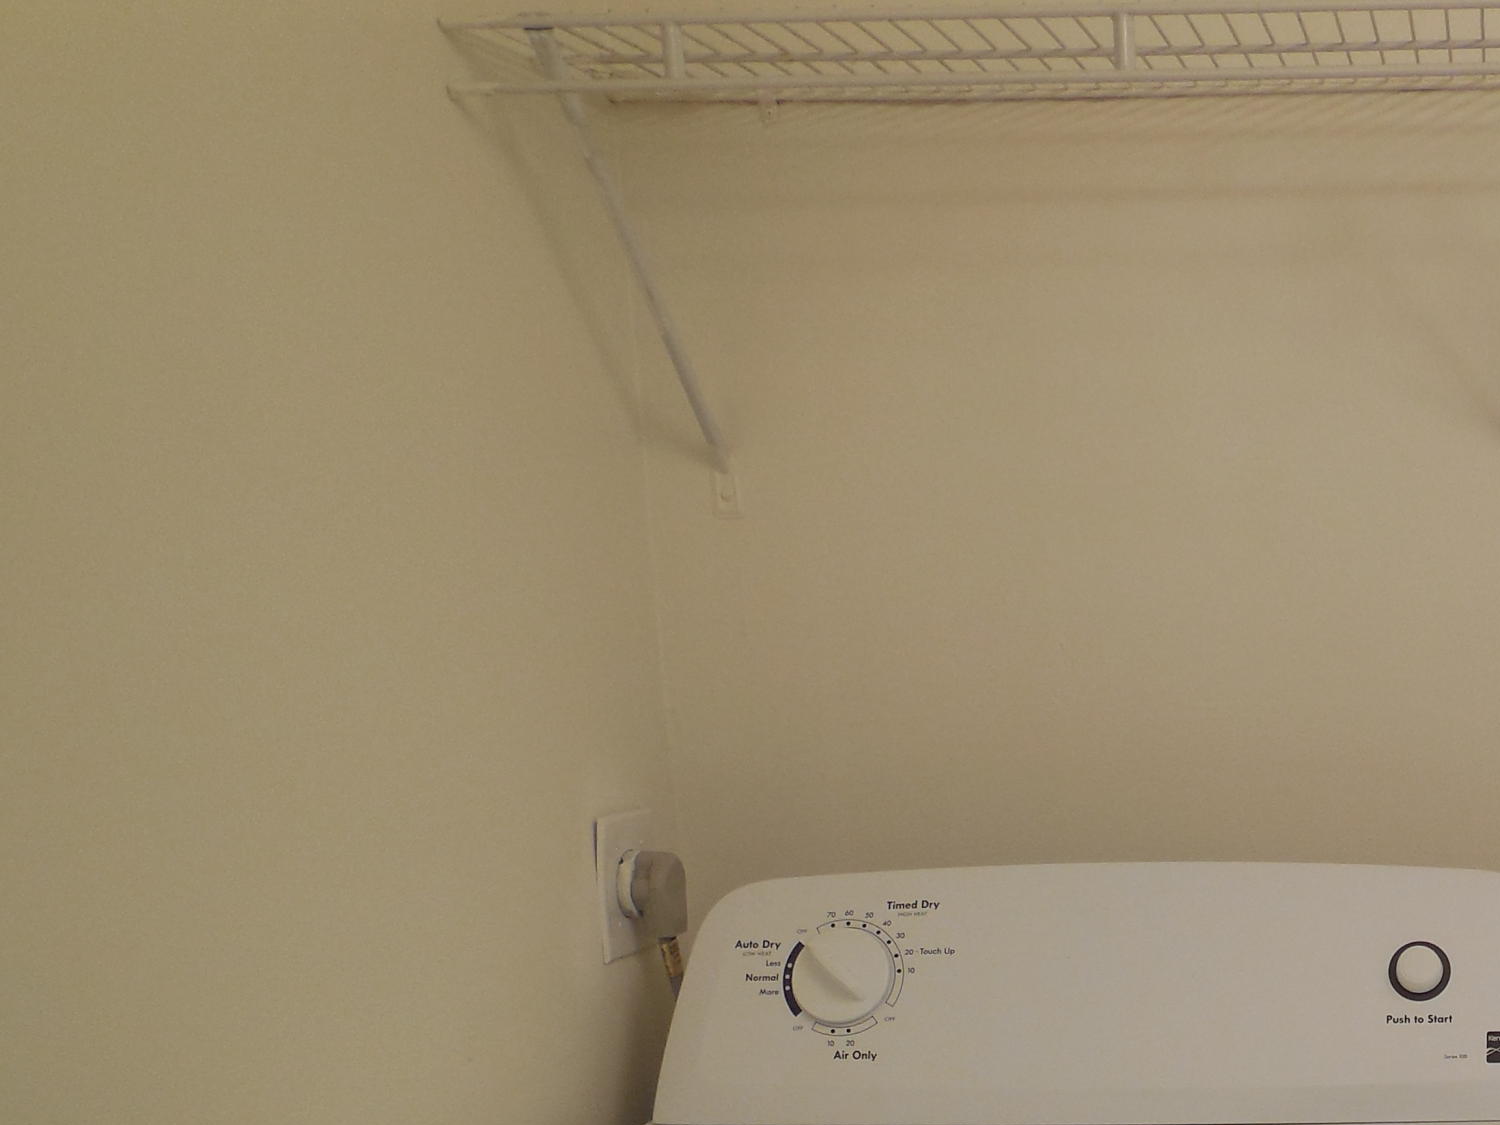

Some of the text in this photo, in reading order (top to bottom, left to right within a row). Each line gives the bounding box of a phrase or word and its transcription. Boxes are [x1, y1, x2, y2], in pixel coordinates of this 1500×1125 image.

[887, 900, 940, 910] Timed Dry
[735, 940, 781, 950] Auto Dry
[944, 948, 956, 957] Up
[746, 974, 779, 982] Normal
[1386, 1014, 1453, 1024] Push to Start
[834, 1050, 877, 1061] Air Only
